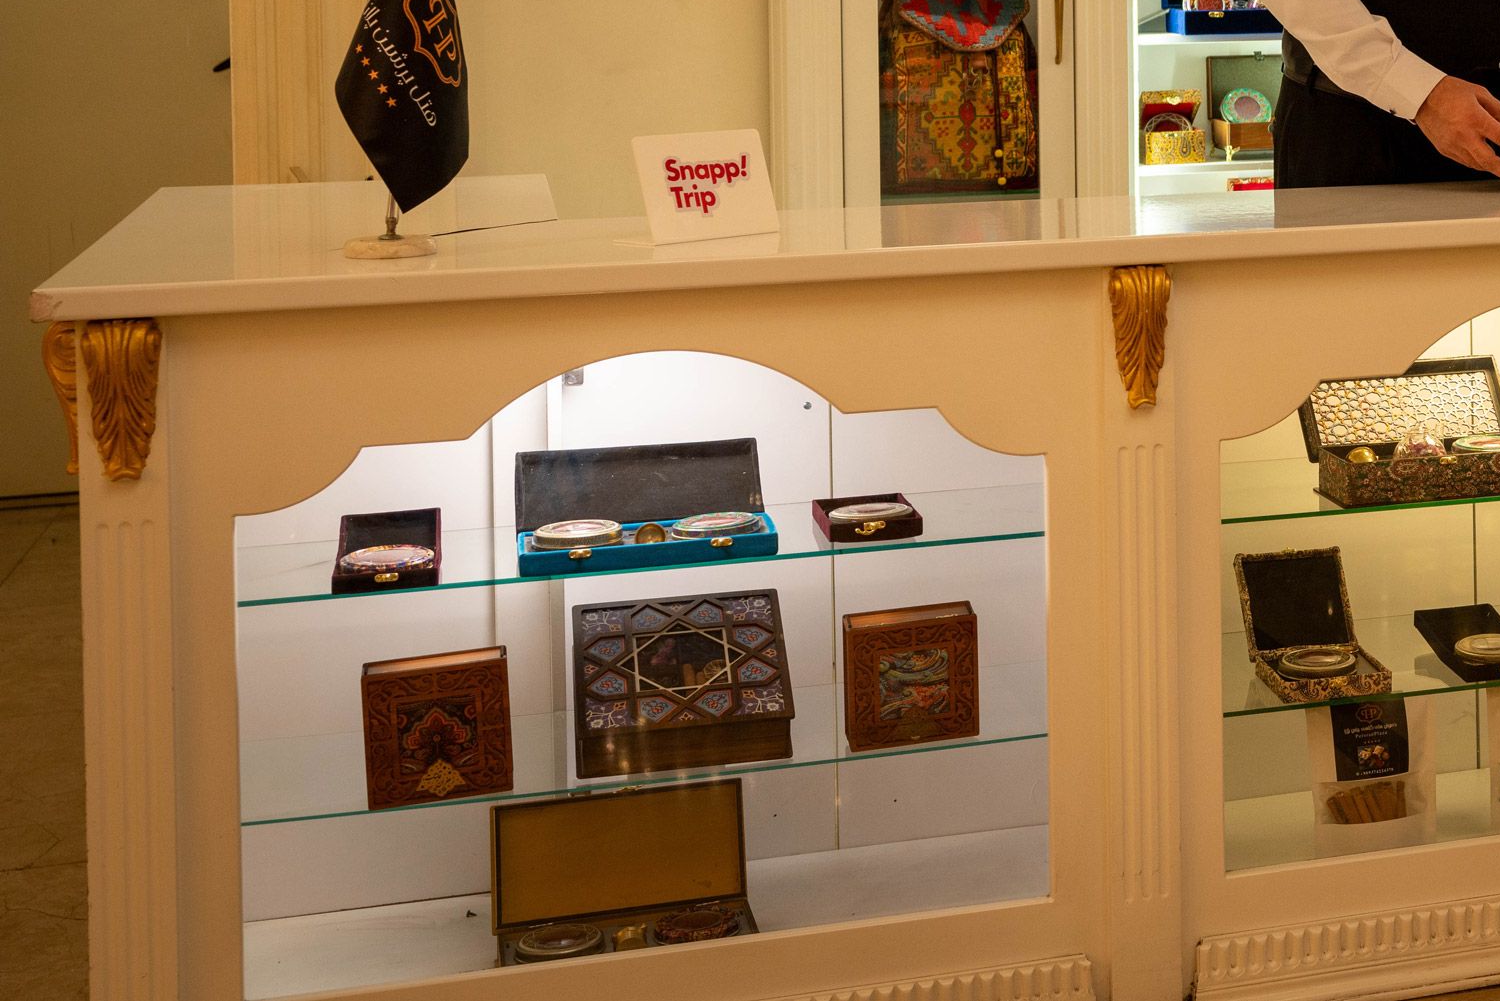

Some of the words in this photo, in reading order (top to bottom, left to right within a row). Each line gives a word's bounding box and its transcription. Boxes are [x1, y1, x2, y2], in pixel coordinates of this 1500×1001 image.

[372, 29, 414, 86] پرشین
[409, 84, 437, 127] هتل
[664, 155, 748, 185] Snapp!
[670, 184, 717, 214] Trip
